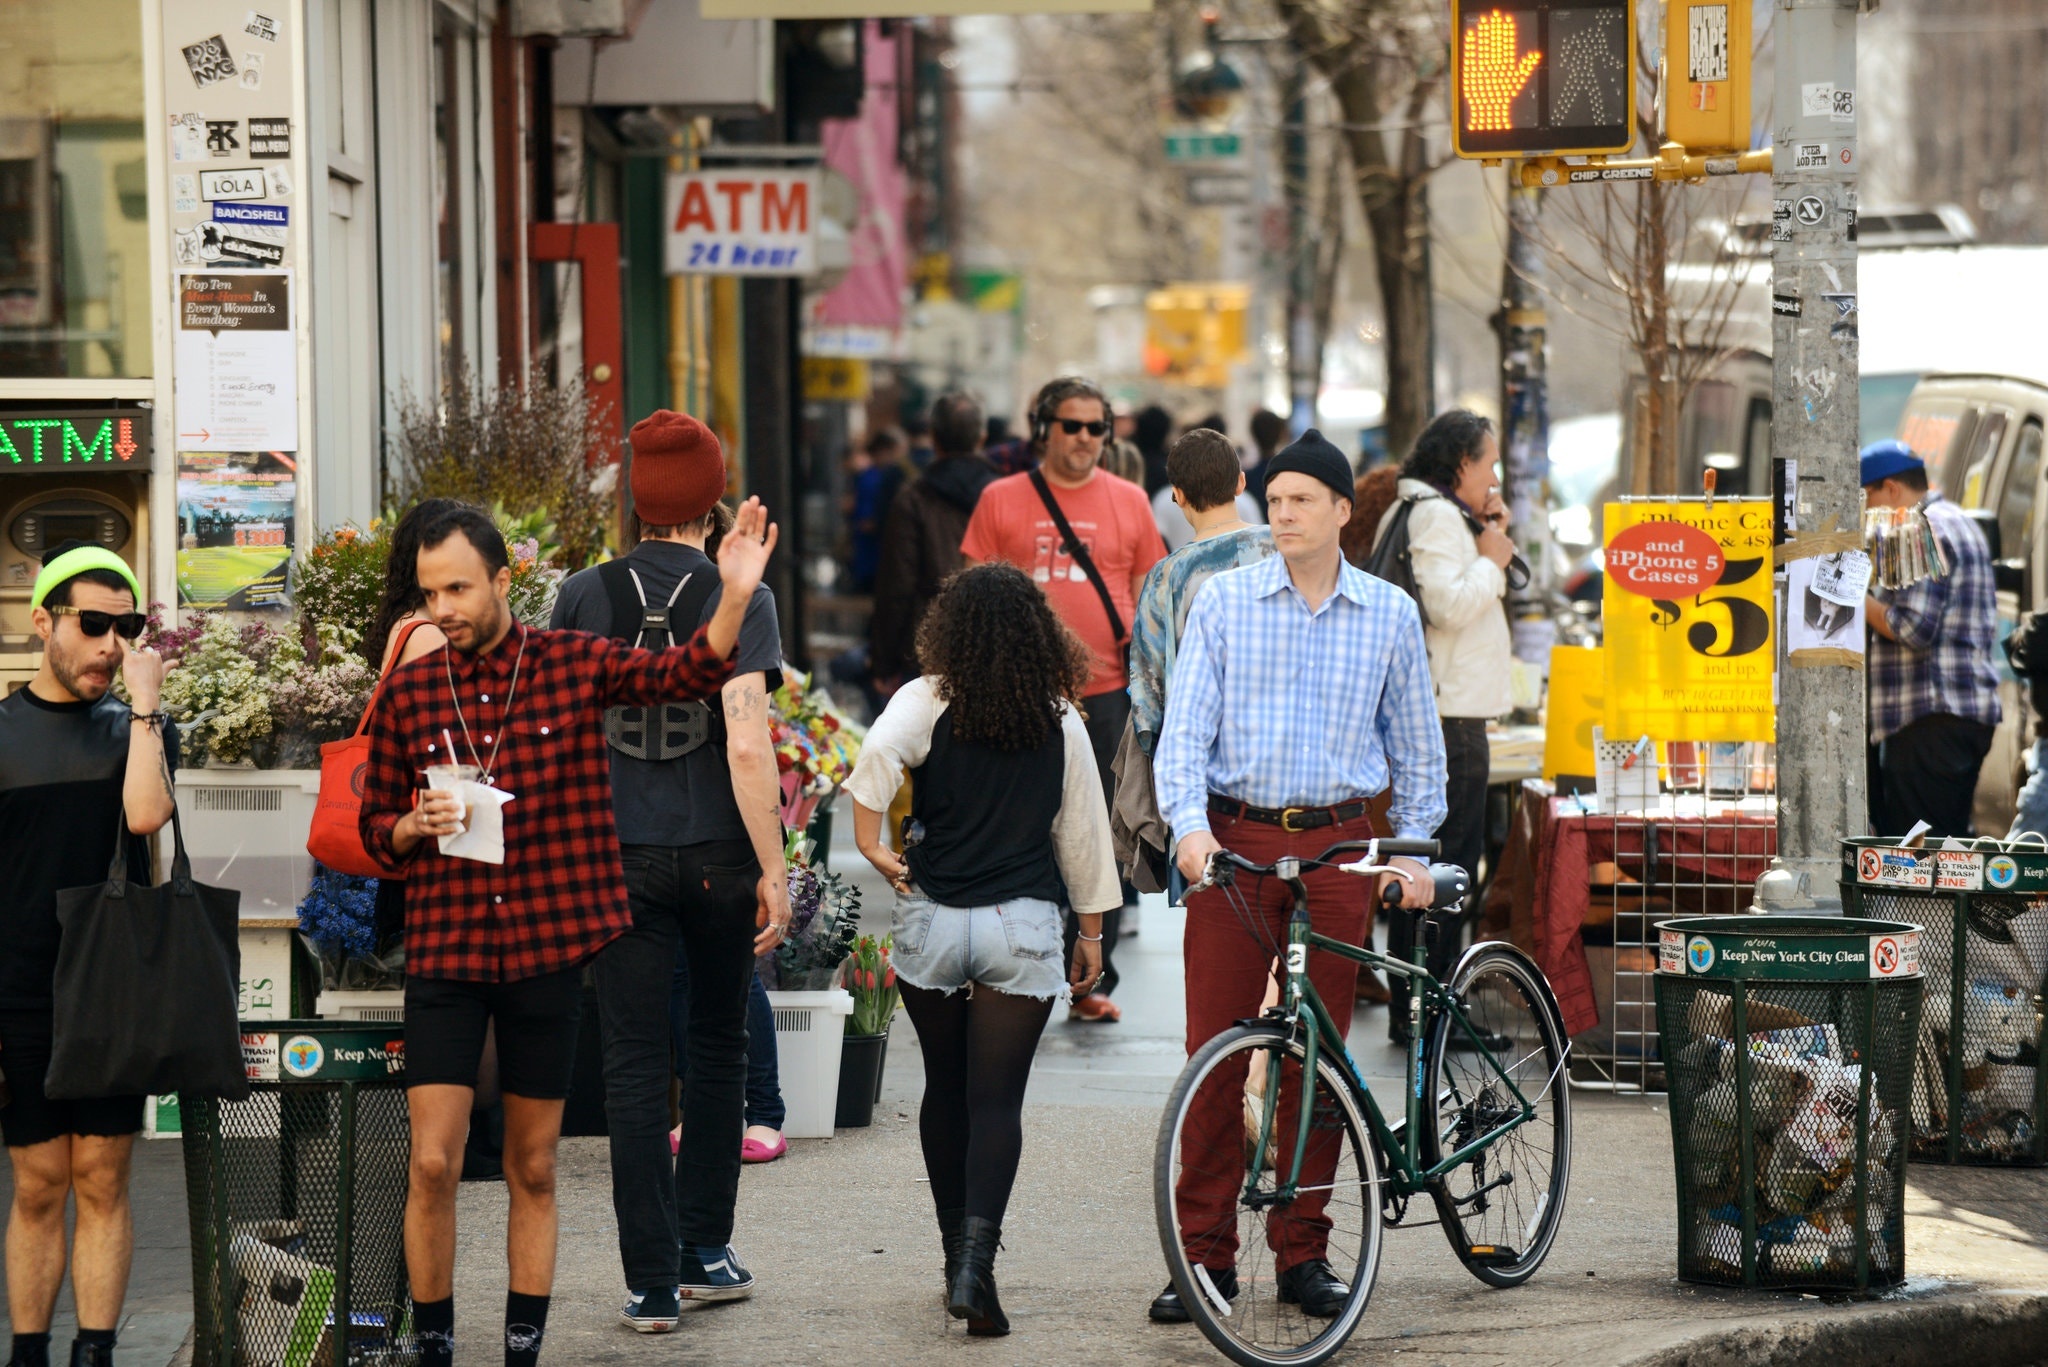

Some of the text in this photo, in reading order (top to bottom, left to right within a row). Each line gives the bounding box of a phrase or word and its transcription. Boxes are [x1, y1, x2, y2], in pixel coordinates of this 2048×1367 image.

[1689, 6, 1727, 27] DOLPHINS
[1689, 27, 1727, 57] RAPE
[1689, 57, 1727, 78] PEOPLE
[1833, 102, 1853, 114] WO
[1571, 167, 1653, 182] CHIP GREENE
[214, 179, 254, 194] LOLA
[674, 180, 808, 234] ATM
[688, 242, 798, 266] 24 hour
[186, 279, 233, 292] Top Ten
[253, 291, 268, 302] In
[185, 303, 276, 316] Every Woman's
[186, 315, 242, 328] Handbag:
[0, 418, 112, 464] ATM
[1646, 539, 1684, 553] and
[1720, 535, 1773, 550] & 4S)
[1611, 551, 1718, 571] iPhone 5
[1629, 567, 1699, 584] Cases
[1703, 661, 1760, 680] and up.
[1663, 688, 1687, 701] BUY
[1708, 688, 1736, 701] GET
[1682, 705, 1700, 713] ALL
[1703, 705, 1735, 713] SALES
[1938, 852, 1973, 862] ONLY
[1944, 870, 1975, 878] TRASH
[1952, 863, 1981, 871] TRASH
[2023, 866, 2044, 878] Keep
[1936, 877, 1967, 887] FINE
[1663, 931, 1680, 943] ONLY
[1722, 949, 1865, 965] Keep New York City Clean
[240, 1035, 267, 1046] NLY
[334, 1048, 365, 1064] Keep
